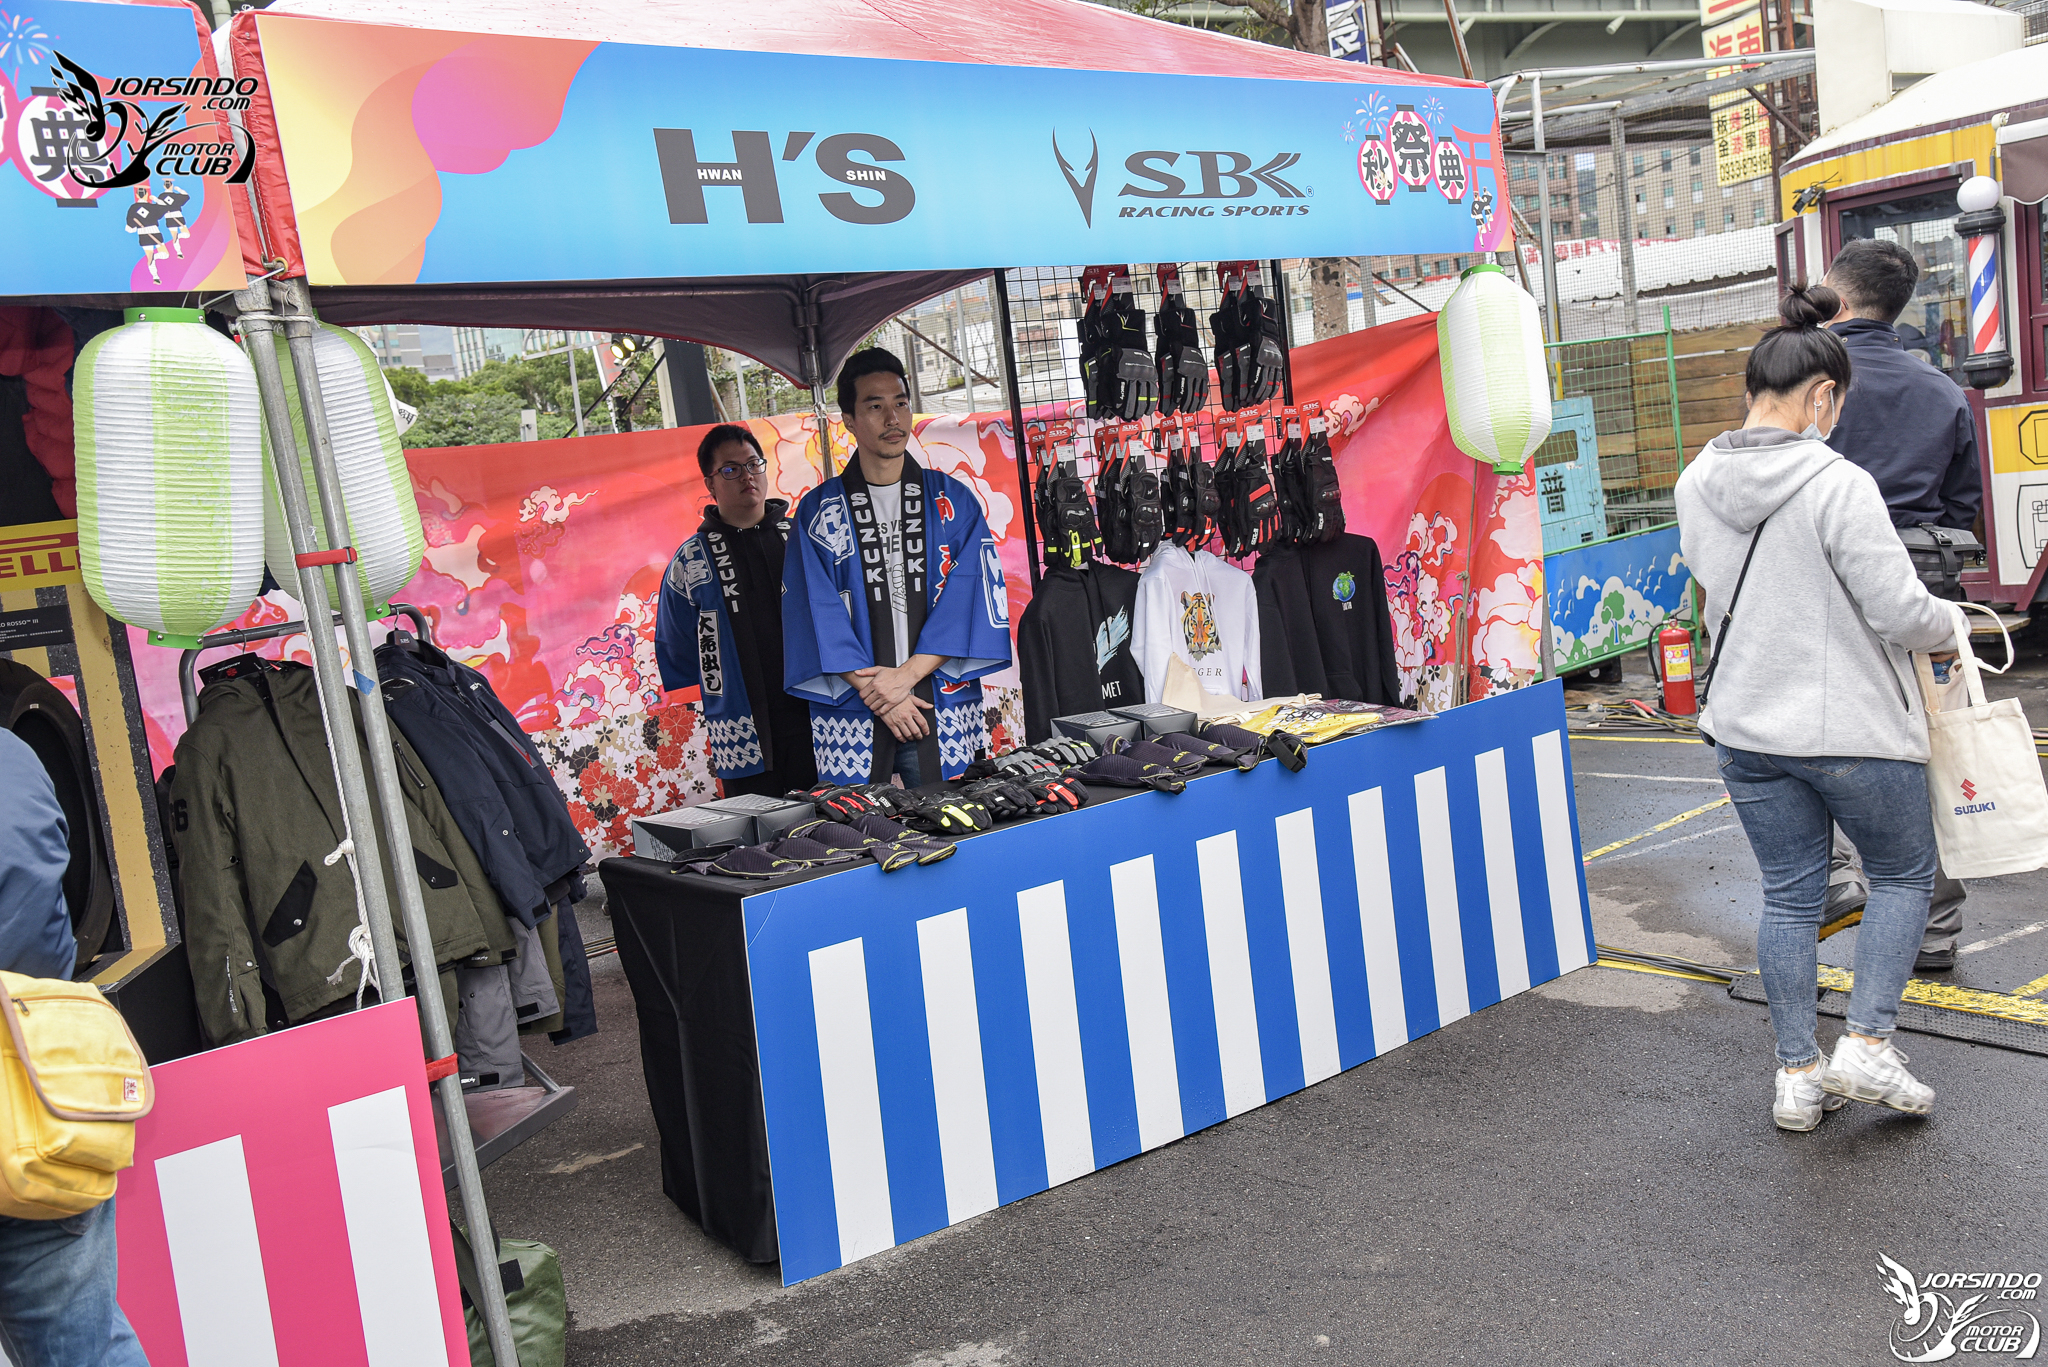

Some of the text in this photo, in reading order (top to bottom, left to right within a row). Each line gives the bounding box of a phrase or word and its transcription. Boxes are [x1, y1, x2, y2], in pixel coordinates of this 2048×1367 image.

[697, 169, 742, 181] HWAN
[846, 170, 886, 181] SHIN
[1118, 205, 1311, 218] RACING SPORTS
[904, 483, 925, 592] SUZUKI
[850, 492, 884, 602] SUZUKI
[707, 531, 740, 613] SUZUKI
[1953, 801, 1996, 816] SUZUKI
